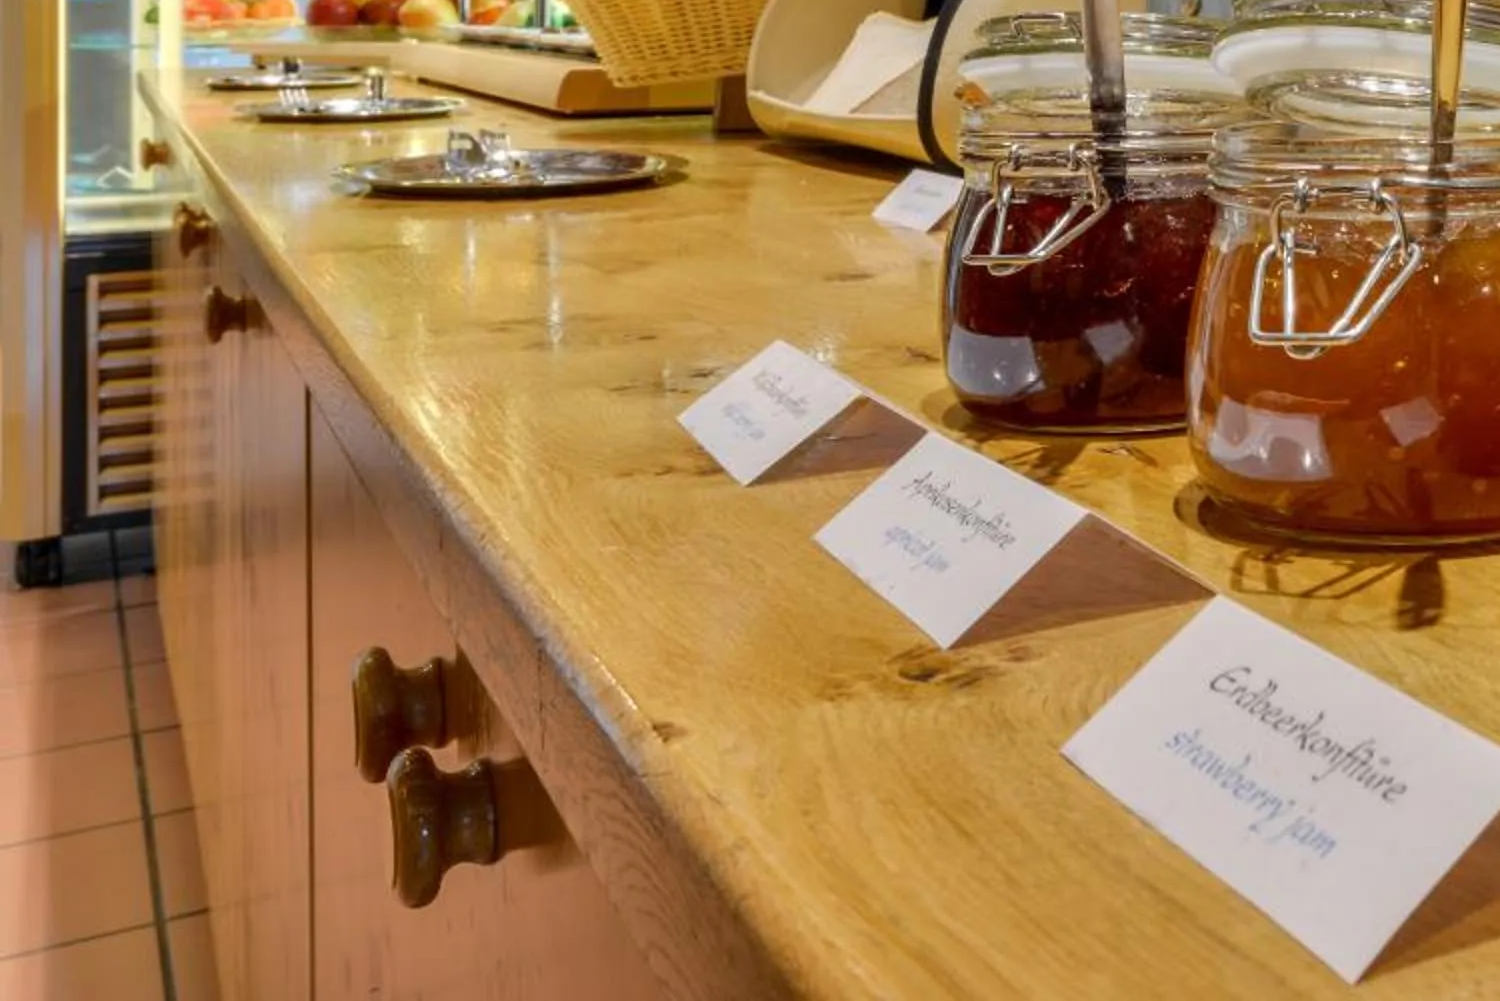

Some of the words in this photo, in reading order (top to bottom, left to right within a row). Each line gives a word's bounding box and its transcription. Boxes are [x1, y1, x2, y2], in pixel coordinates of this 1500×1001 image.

[1165, 728, 1296, 832] strawberry
[1267, 806, 1337, 859] jam
[1209, 665, 1408, 804] Erdbeerkonfitüre
